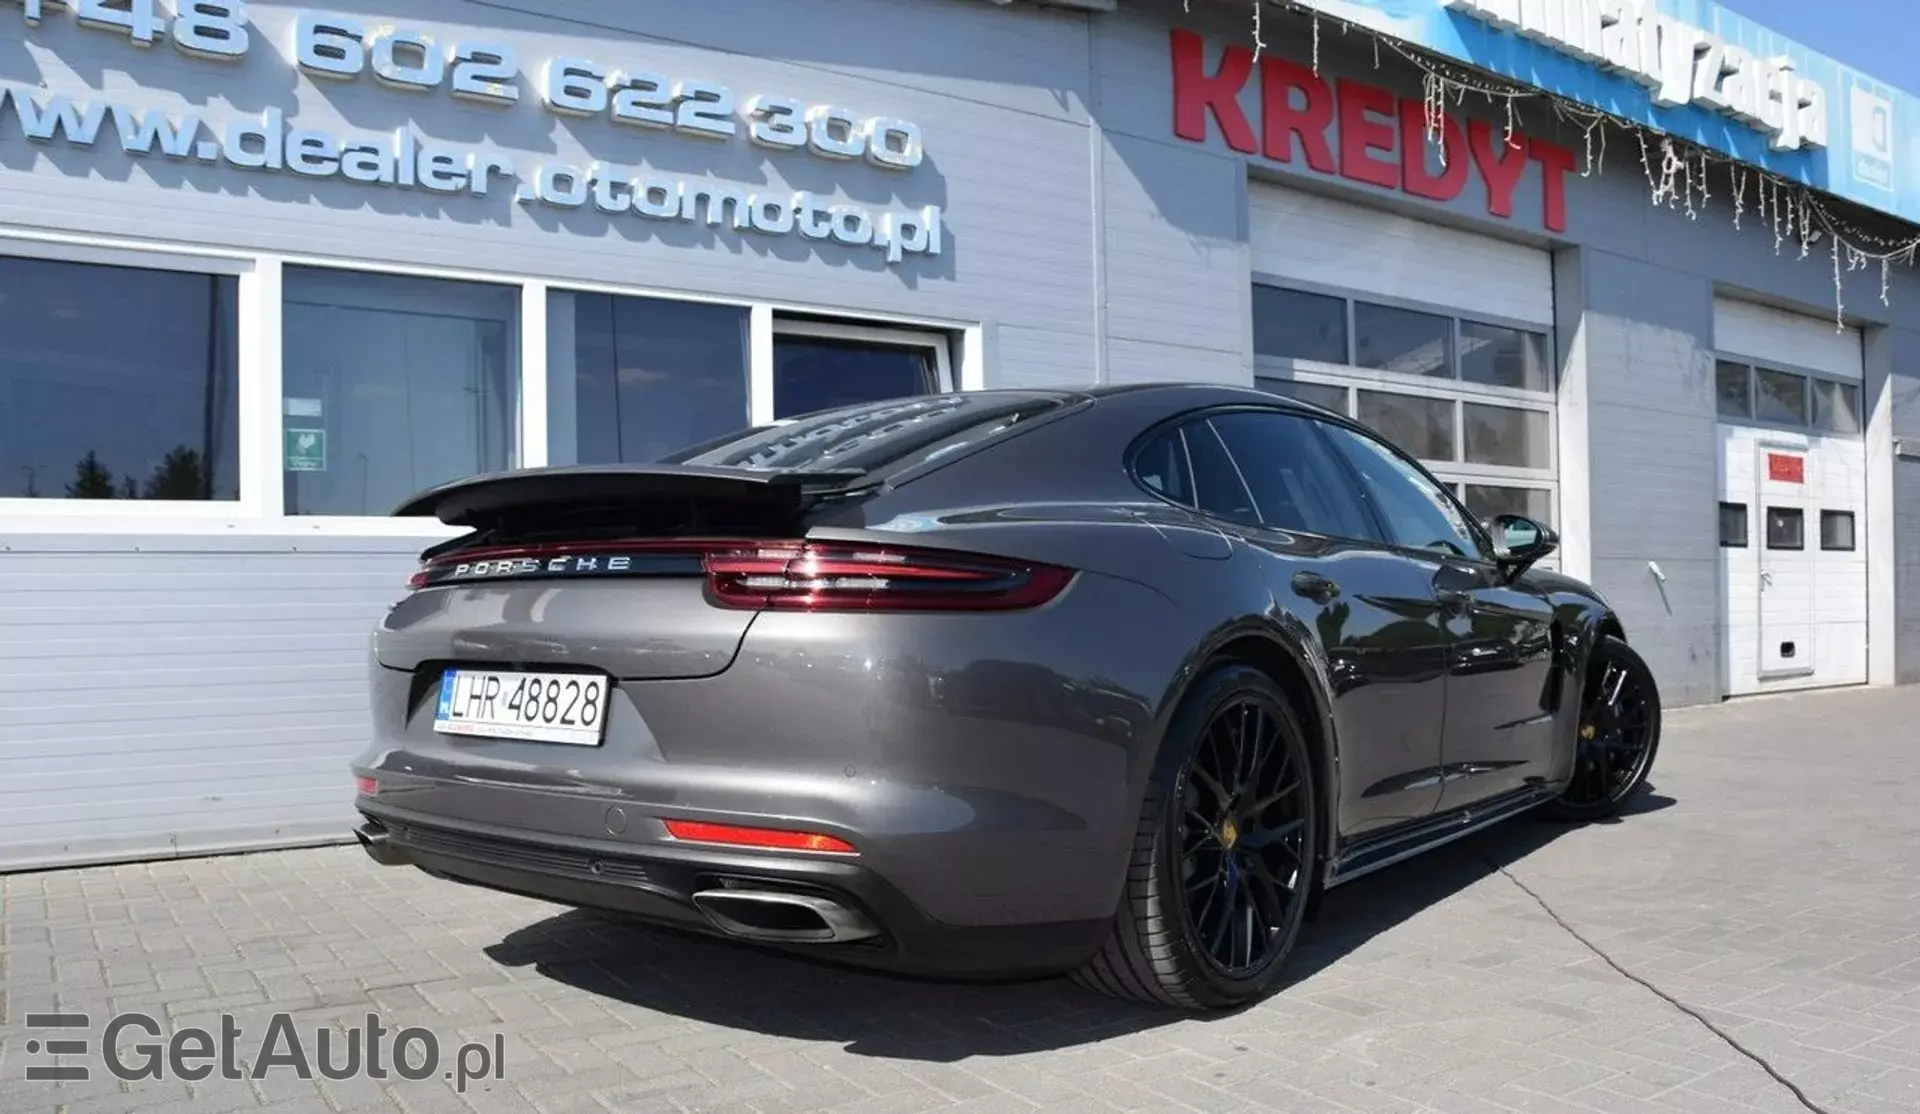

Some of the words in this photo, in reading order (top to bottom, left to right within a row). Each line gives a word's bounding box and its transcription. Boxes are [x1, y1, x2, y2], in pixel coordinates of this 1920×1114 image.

[296, 17, 518, 104] 602
[541, 55, 736, 138] 622
[744, 94, 923, 169] 300
[1170, 28, 1576, 233] KREDYT
[0, 84, 941, 262] ww.dealer.otomoto.pl
[454, 556, 631, 577] PORSCHE
[452, 675, 501, 720] LHR
[508, 677, 600, 726] 48828
